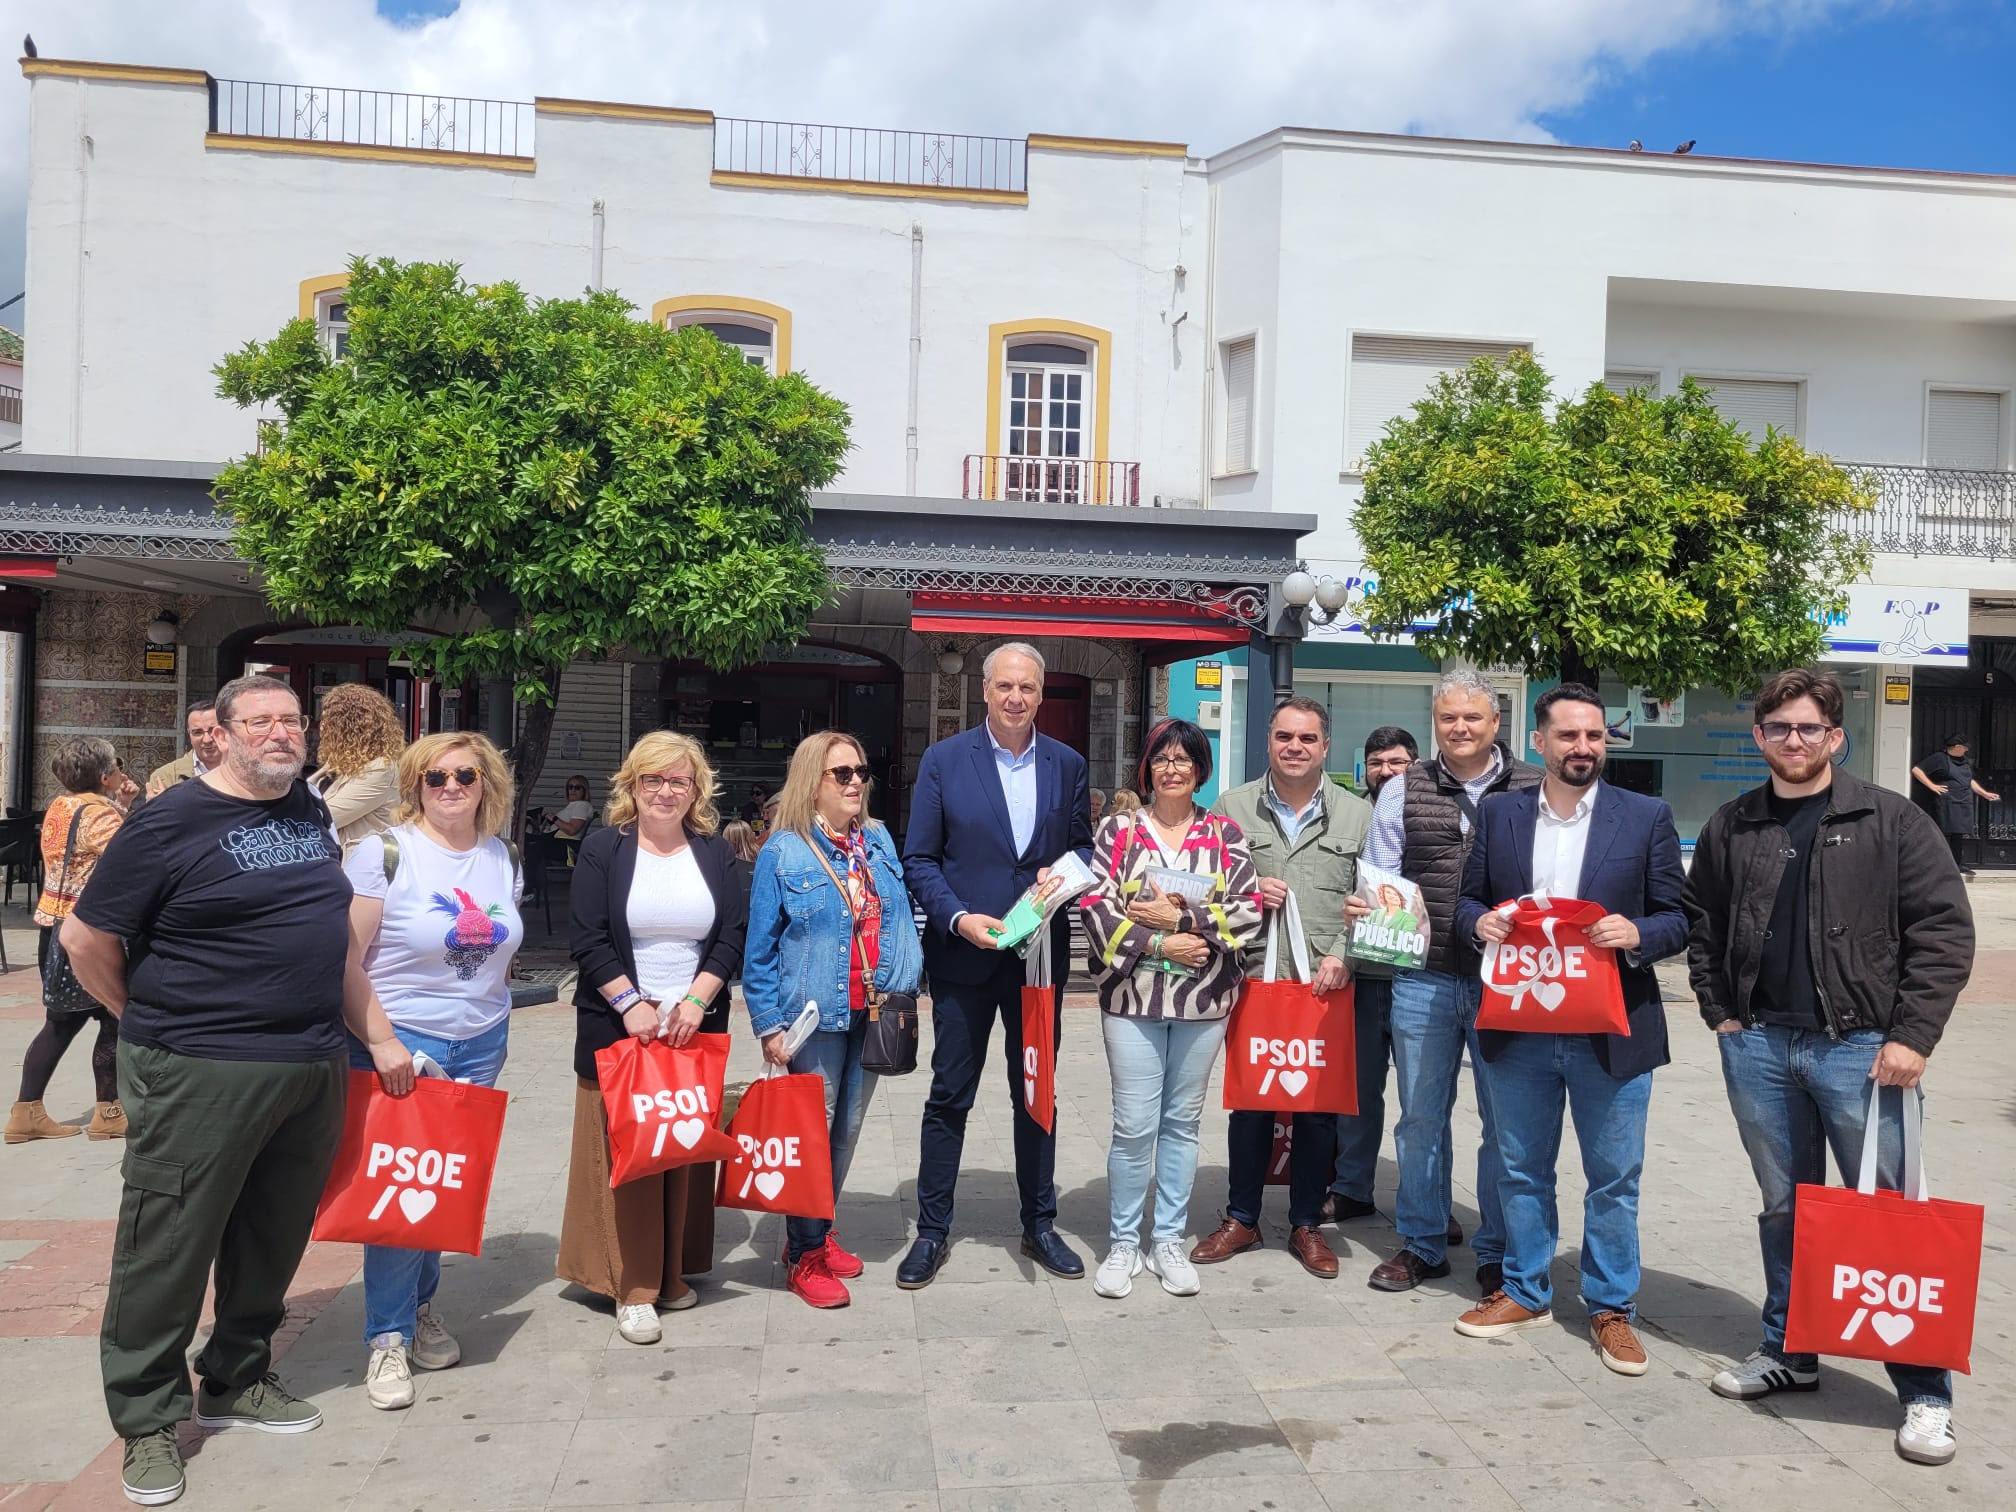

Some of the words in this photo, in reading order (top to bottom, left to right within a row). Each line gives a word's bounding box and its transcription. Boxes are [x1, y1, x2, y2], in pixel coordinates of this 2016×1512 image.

[1985, 672, 1994, 684] 5
[219, 818, 292, 852] Can't
[286, 817, 321, 842] be
[233, 841, 330, 871] known
[1499, 944, 1587, 978] PSOE
[1250, 1037, 1326, 1067] PSOE
[366, 1142, 467, 1189] PSOE
[1832, 1264, 1946, 1314] PSOE
